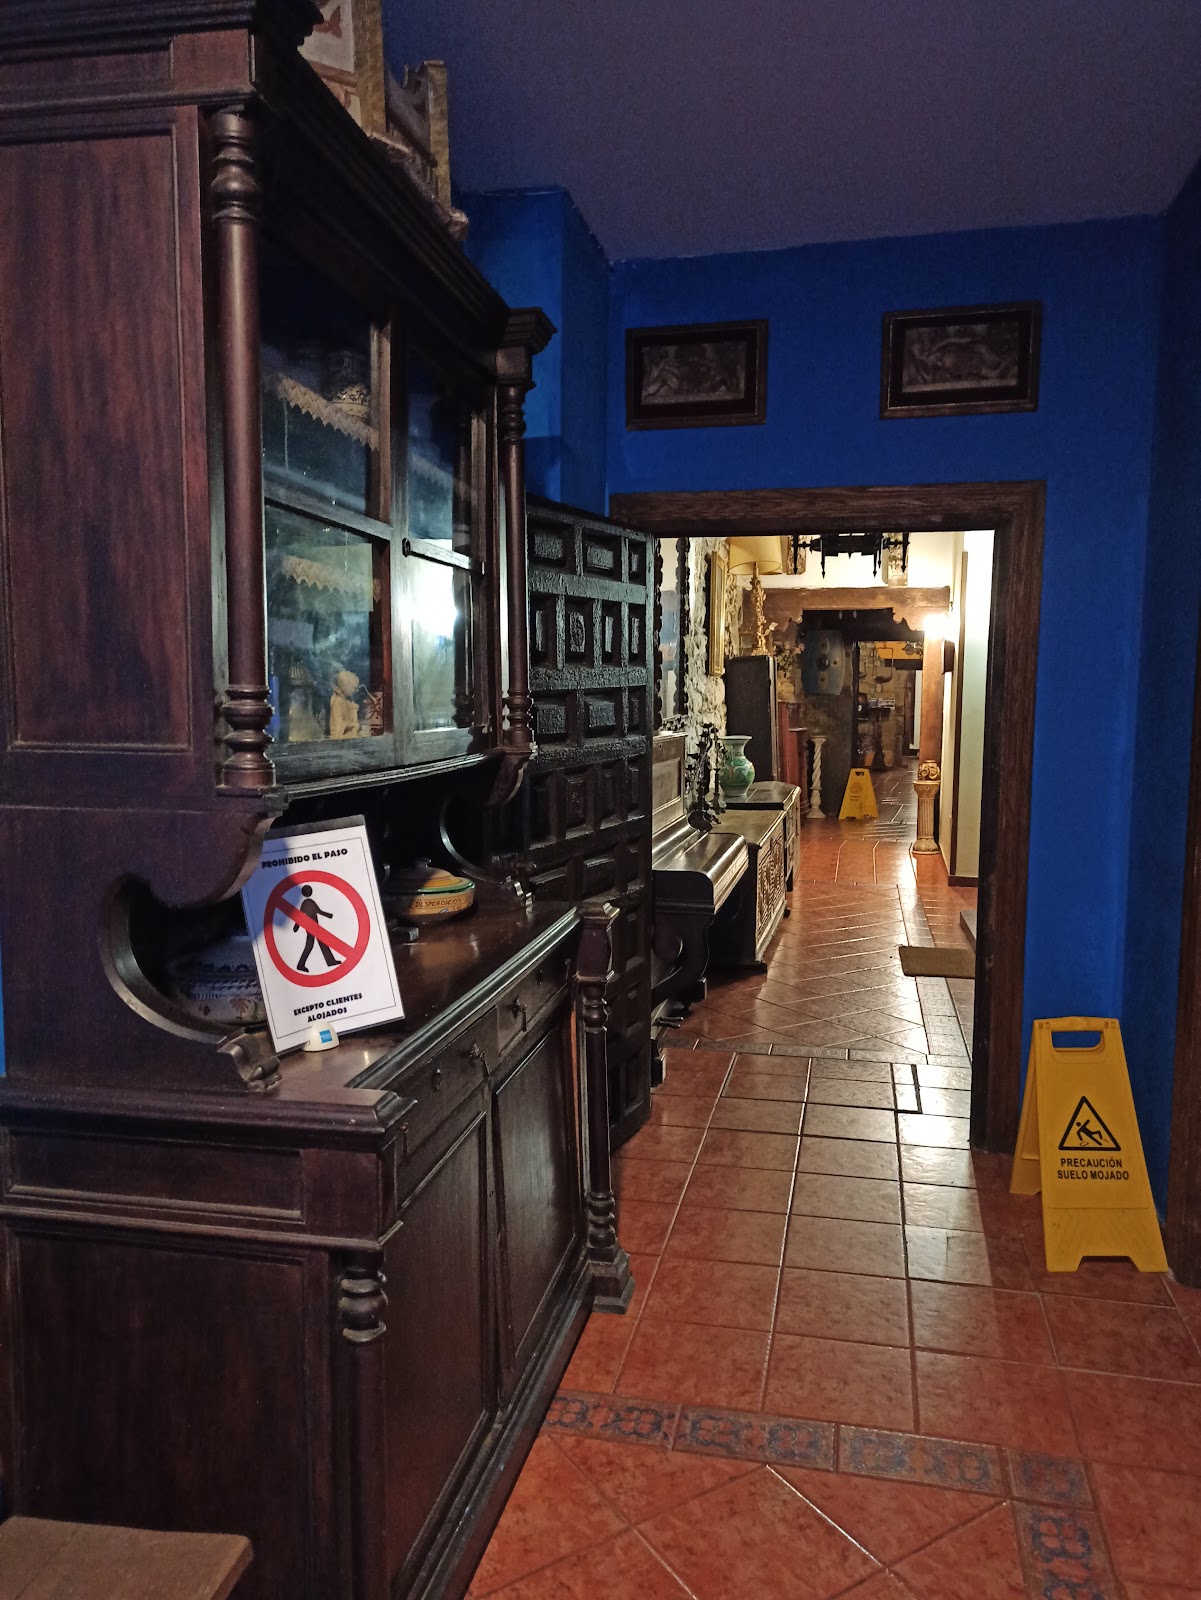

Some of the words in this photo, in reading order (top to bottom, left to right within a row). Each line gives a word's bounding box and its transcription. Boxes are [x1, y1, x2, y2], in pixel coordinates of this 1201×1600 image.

[261, 854, 310, 869] PROHIBIDO
[312, 853, 322, 861] EL
[324, 848, 348, 859] PASO
[293, 1002, 324, 1016] EXCEPTO
[326, 992, 362, 1007] CLIENTES
[307, 1007, 347, 1022] ALOJADOS
[1060, 1156, 1122, 1168] PRECAUCIÓN
[1057, 1170, 1088, 1180] SUELO
[1090, 1170, 1129, 1180] MOJADO
